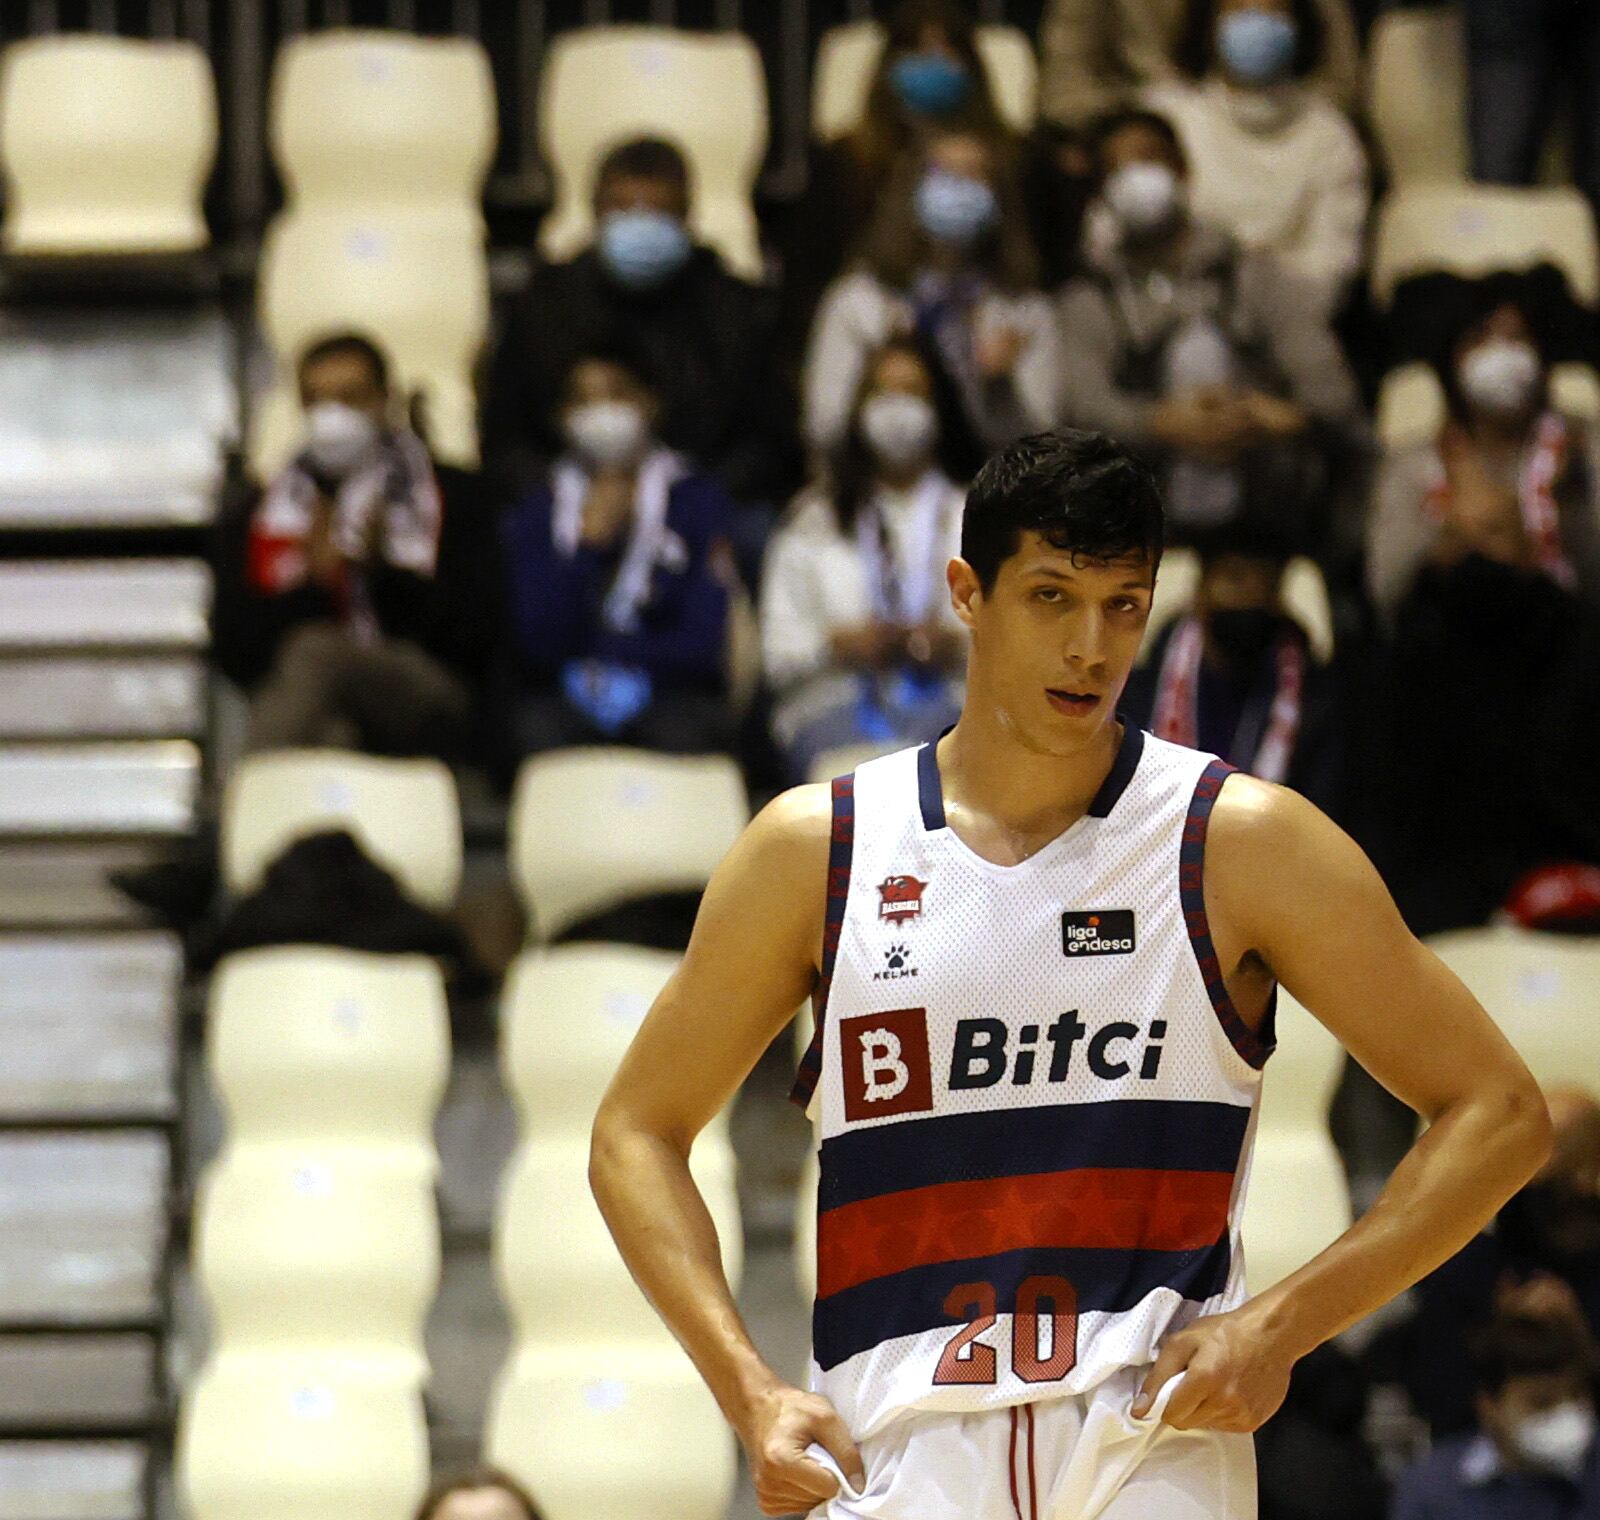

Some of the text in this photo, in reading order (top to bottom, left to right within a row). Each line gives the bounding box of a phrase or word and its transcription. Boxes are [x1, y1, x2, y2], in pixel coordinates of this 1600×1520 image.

[1067, 924, 1097, 941] liga
[1068, 937, 1132, 952] endesa
[873, 968, 919, 980] KELME
[948, 1009, 1168, 1091] Bitci
[932, 1275, 1080, 1386] 20
